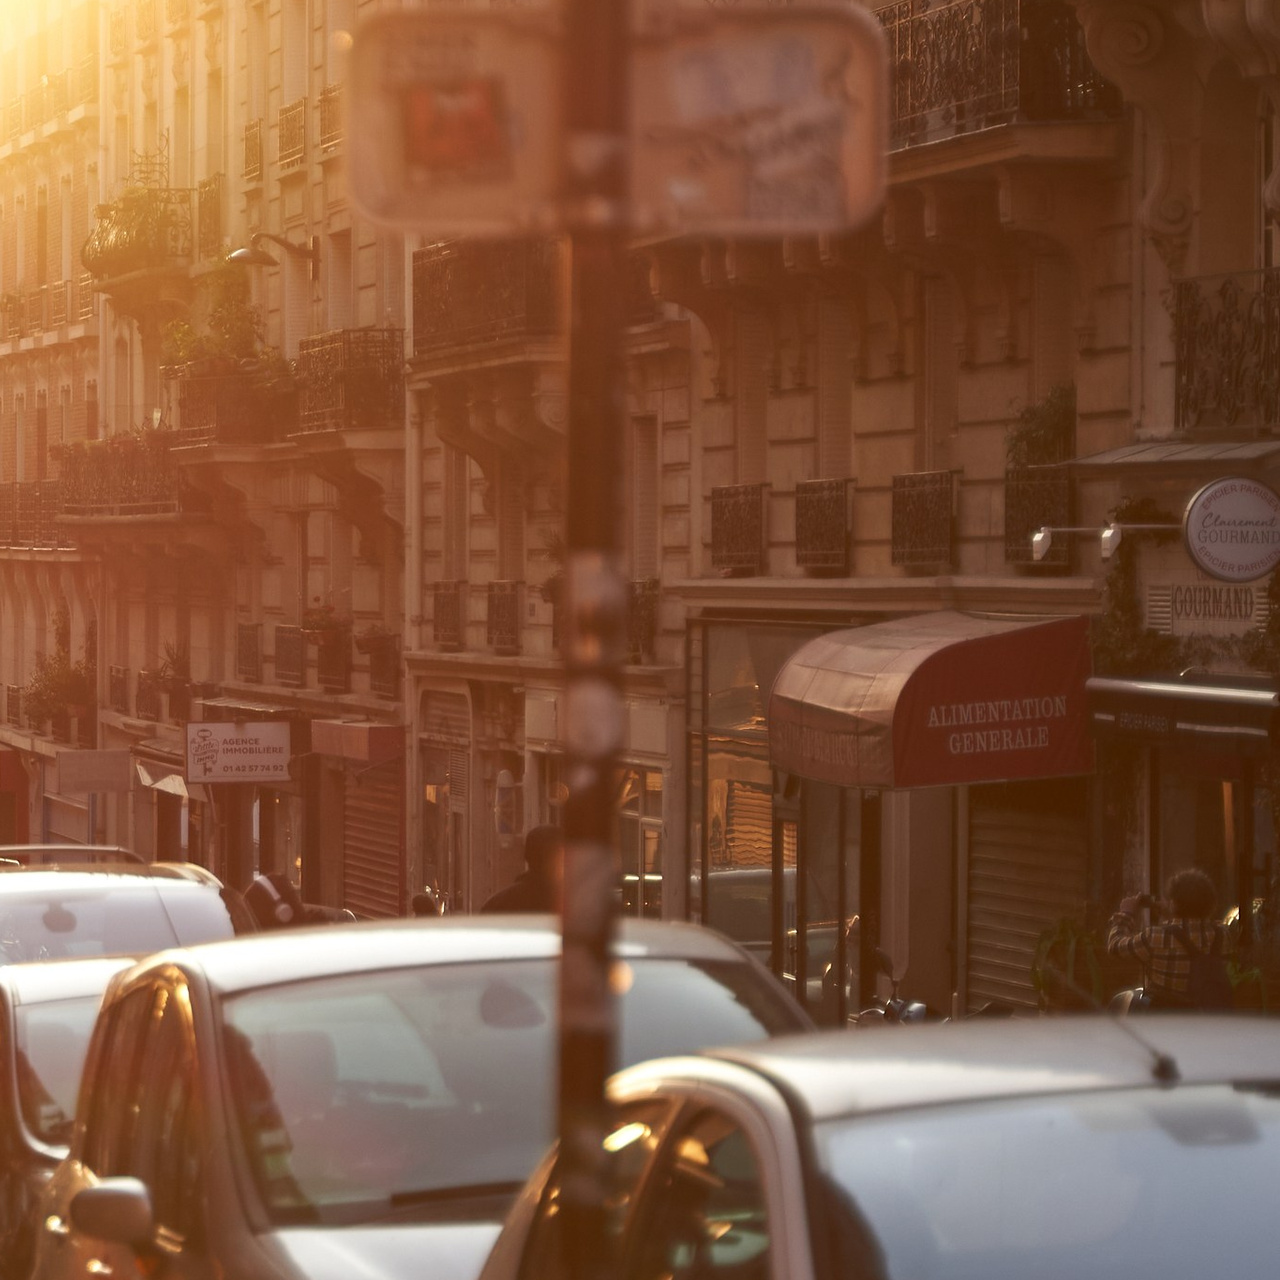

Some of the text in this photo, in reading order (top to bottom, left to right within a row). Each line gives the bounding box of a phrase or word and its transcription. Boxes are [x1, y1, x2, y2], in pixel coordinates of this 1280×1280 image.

[1201, 483, 1238, 511] EPICIER
[1201, 512, 1278, 529] Clairement
[1197, 528, 1280, 544] GOURMAND
[1197, 545, 1235, 573] EPICIER
[1174, 585, 1254, 619] GOURMAND
[927, 695, 1068, 728] ALIMENTATION
[222, 738, 260, 746] AGENCE
[222, 745, 284, 755] IMMOBILIÈRE
[949, 726, 1050, 754] GENERALE
